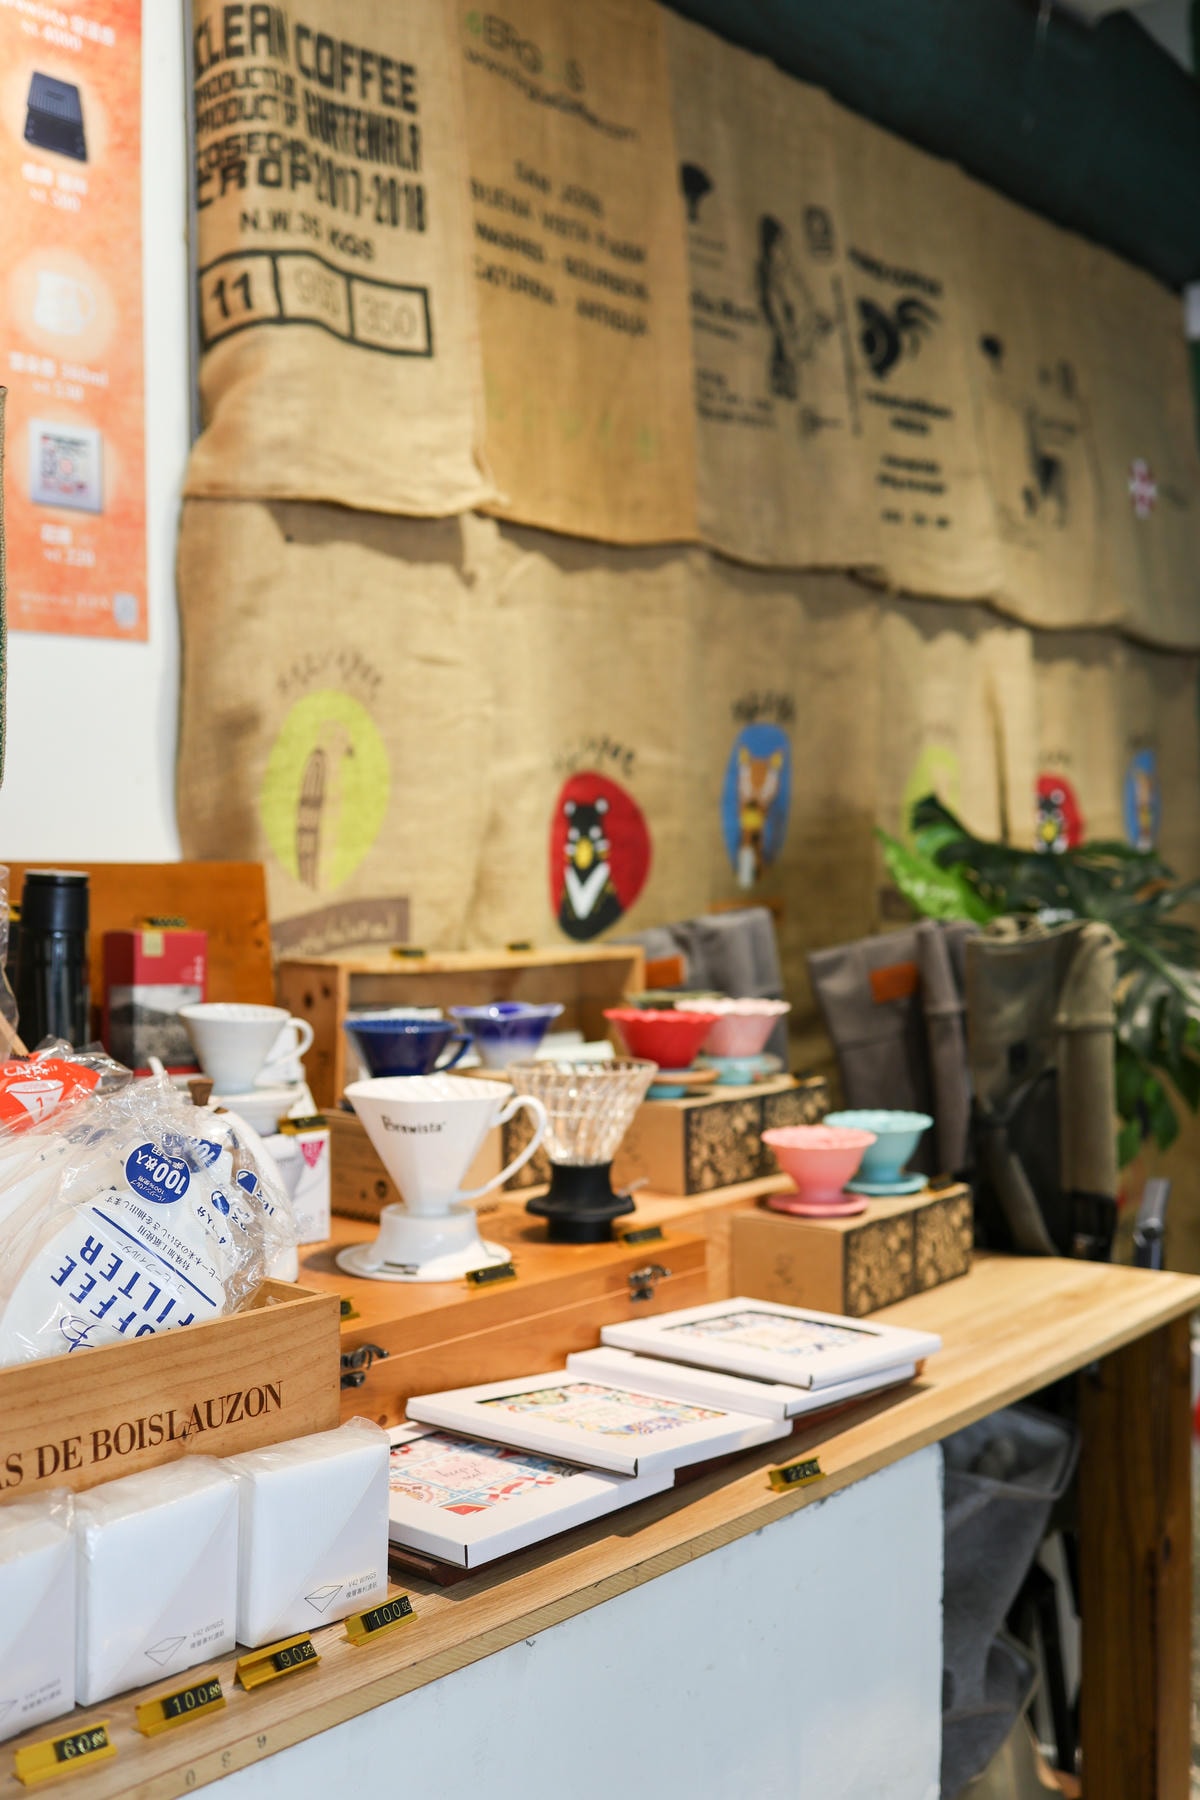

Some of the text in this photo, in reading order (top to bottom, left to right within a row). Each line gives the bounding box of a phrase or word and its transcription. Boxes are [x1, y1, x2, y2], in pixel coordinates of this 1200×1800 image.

[294, 22, 417, 115] COFFEE
[210, 271, 253, 319] 11
[136, 1150, 187, 1195] 100枚入
[35, 1435, 84, 1480] DE
[89, 1381, 284, 1465] BOISLAUZON
